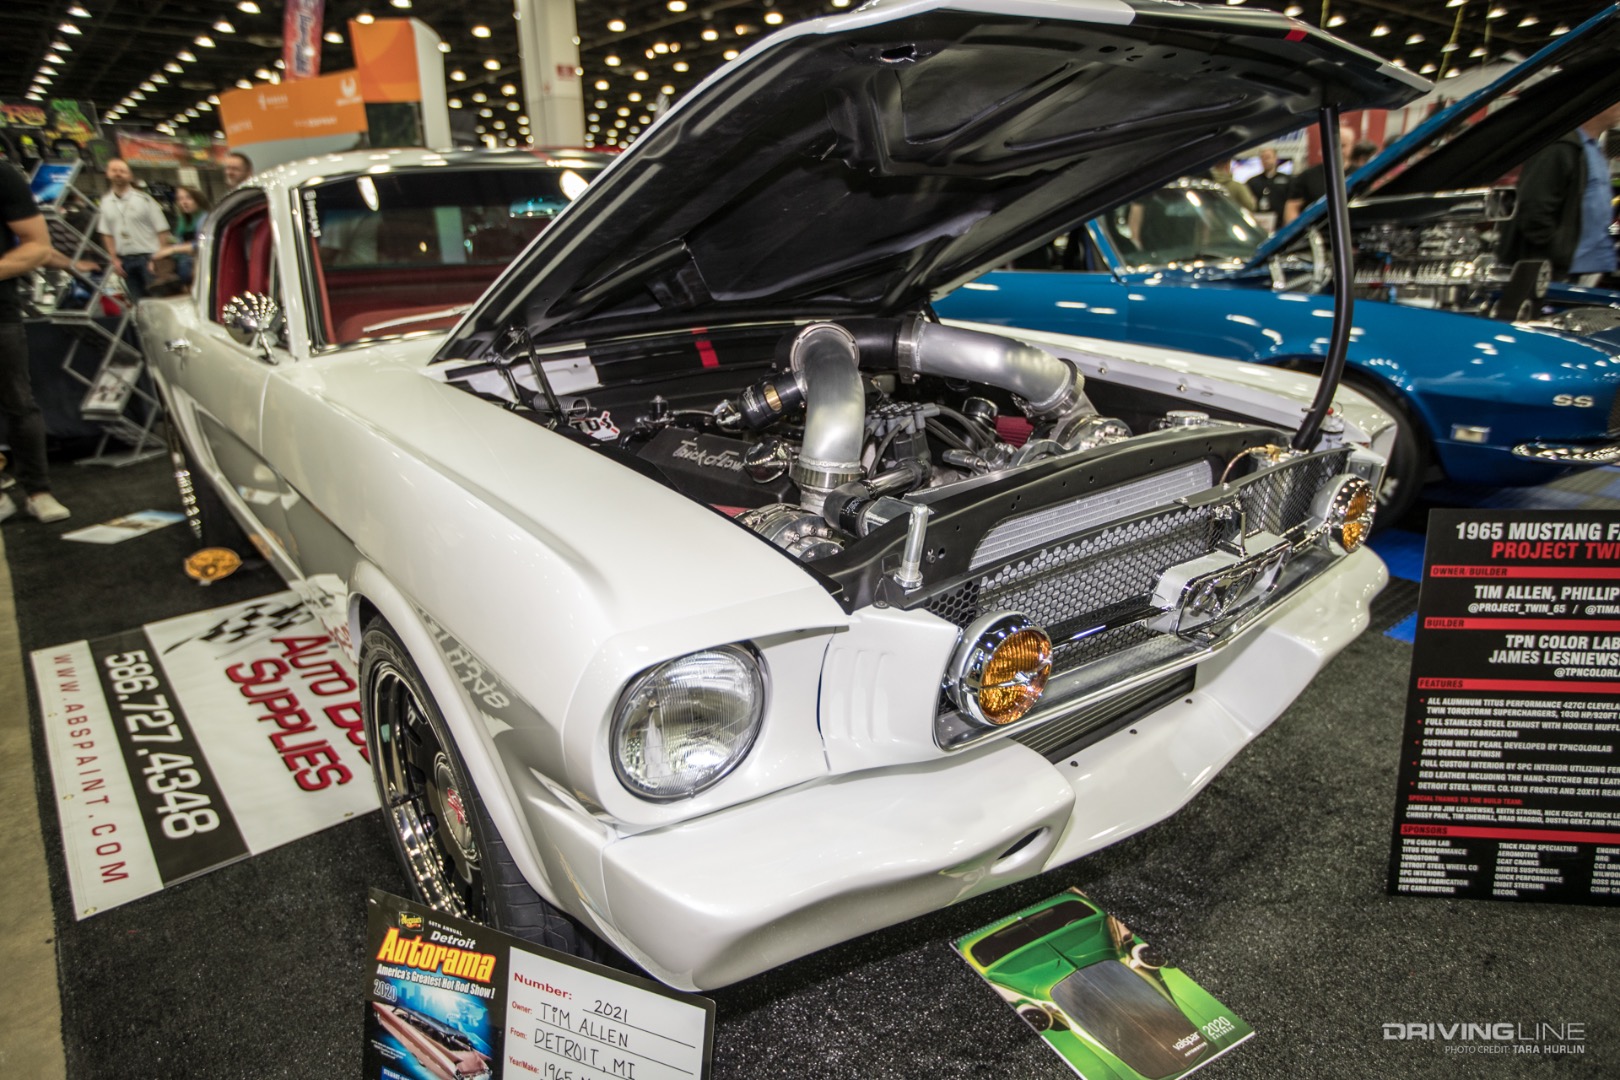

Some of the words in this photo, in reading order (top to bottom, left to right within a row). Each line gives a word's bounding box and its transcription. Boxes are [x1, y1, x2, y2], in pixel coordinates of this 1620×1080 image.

[1552, 394, 1594, 408] SS
[1456, 522, 1503, 540] 1965
[1508, 523, 1601, 541] MUSTANG
[1491, 542, 1579, 559] PROJECT
[1474, 585, 1502, 599] TIM
[1505, 586, 1557, 602] ALLEN,
[1468, 603, 1566, 615] @PROJECT_TWIN_65
[1426, 619, 1464, 628] BUILDER
[1505, 635, 1534, 648] TPN
[1538, 635, 1588, 649] COLOR
[1592, 637, 1620, 650] LAB
[1489, 650, 1540, 664] JAMES
[270, 634, 358, 697] AUTO
[1419, 680, 1463, 688] FEATURES
[1427, 697, 1441, 705] ALL
[1442, 698, 1482, 706] ALUMINUM
[1484, 699, 1505, 707] TITUS
[1505, 700, 1562, 709] PERFORMANCE
[1447, 707, 1492, 715] TORQSTORM
[225, 658, 353, 792] SUPPLIES
[1425, 718, 1443, 726] FULL
[1507, 721, 1540, 729] EXHAUST
[1562, 722, 1593, 730] HOOKER
[1435, 728, 1469, 736] DIAMOND
[1470, 729, 1518, 738] FABRICATION
[103, 650, 220, 838] 586.727.4348
[1423, 739, 1454, 747] CUSTOM
[1454, 740, 1478, 748] WHITE
[1504, 741, 1546, 750] DEVELOPED
[1421, 748, 1437, 756] AND
[1467, 750, 1502, 758] REFINISH
[53, 653, 129, 884] WWW.ABSPAINT.COM
[1420, 759, 1438, 768] FULL
[1439, 760, 1470, 768] CUSTOM
[1471, 761, 1505, 769] INTERIOR
[1506, 762, 1517, 770] BY
[1534, 764, 1568, 772] INTERIOR
[1569, 765, 1606, 773] UTILIZING
[1435, 771, 1467, 779] LEATHER
[1467, 772, 1506, 781] INCLUDING
[1418, 782, 1448, 790] DETROIT
[1449, 783, 1470, 791] STEEL
[1471, 784, 1496, 792] WHEEL
[1529, 786, 1559, 794] FRONTS
[1559, 787, 1575, 795] AND
[1403, 826, 1448, 834] SPONSORS
[430, 931, 476, 949] Detroit
[376, 926, 496, 983] Autorama
[376, 963, 411, 980] America's
[411, 970, 441, 987] Greatest
[441, 977, 455, 990] Hot
[456, 981, 469, 993] Rod
[513, 971, 573, 1001] Number:
[374, 978, 398, 1002] 2020
[511, 1000, 533, 1016] Owner:
[594, 999, 629, 1024] 2021
[510, 1026, 528, 1041] From:
[578, 1015, 629, 1048] ALLEN
[1202, 1016, 1231, 1036] 2020
[1172, 1032, 1200, 1051] valspar
[508, 1055, 540, 1075] Year/Make:
[612, 1057, 635, 1078] MI
